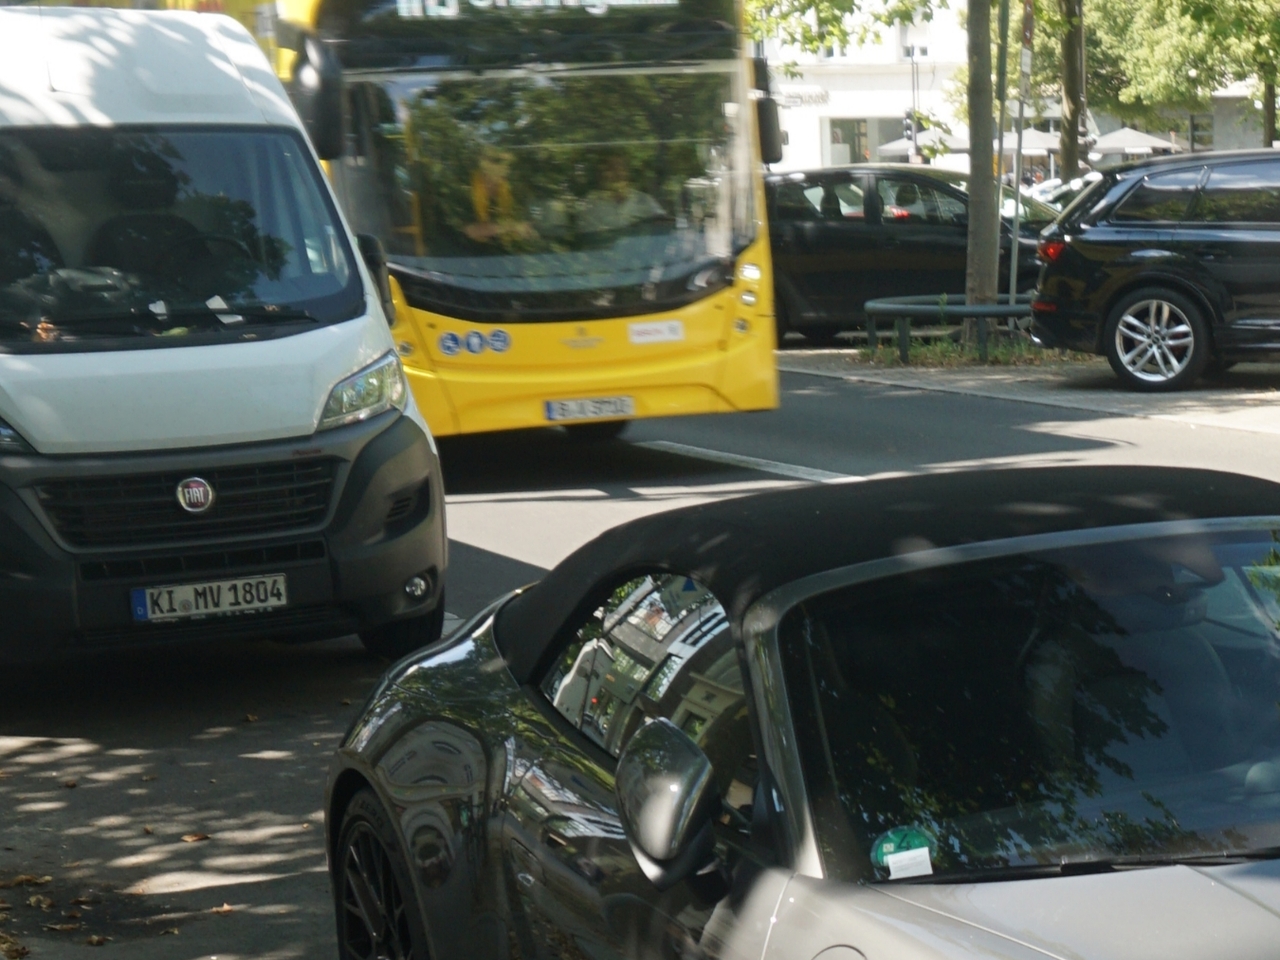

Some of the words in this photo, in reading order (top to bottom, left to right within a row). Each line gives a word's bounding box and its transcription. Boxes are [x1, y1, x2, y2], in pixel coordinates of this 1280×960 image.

[184, 487, 204, 503] FIAT
[150, 590, 177, 615] KI
[193, 585, 221, 609] MV
[228, 579, 283, 606] 1804
